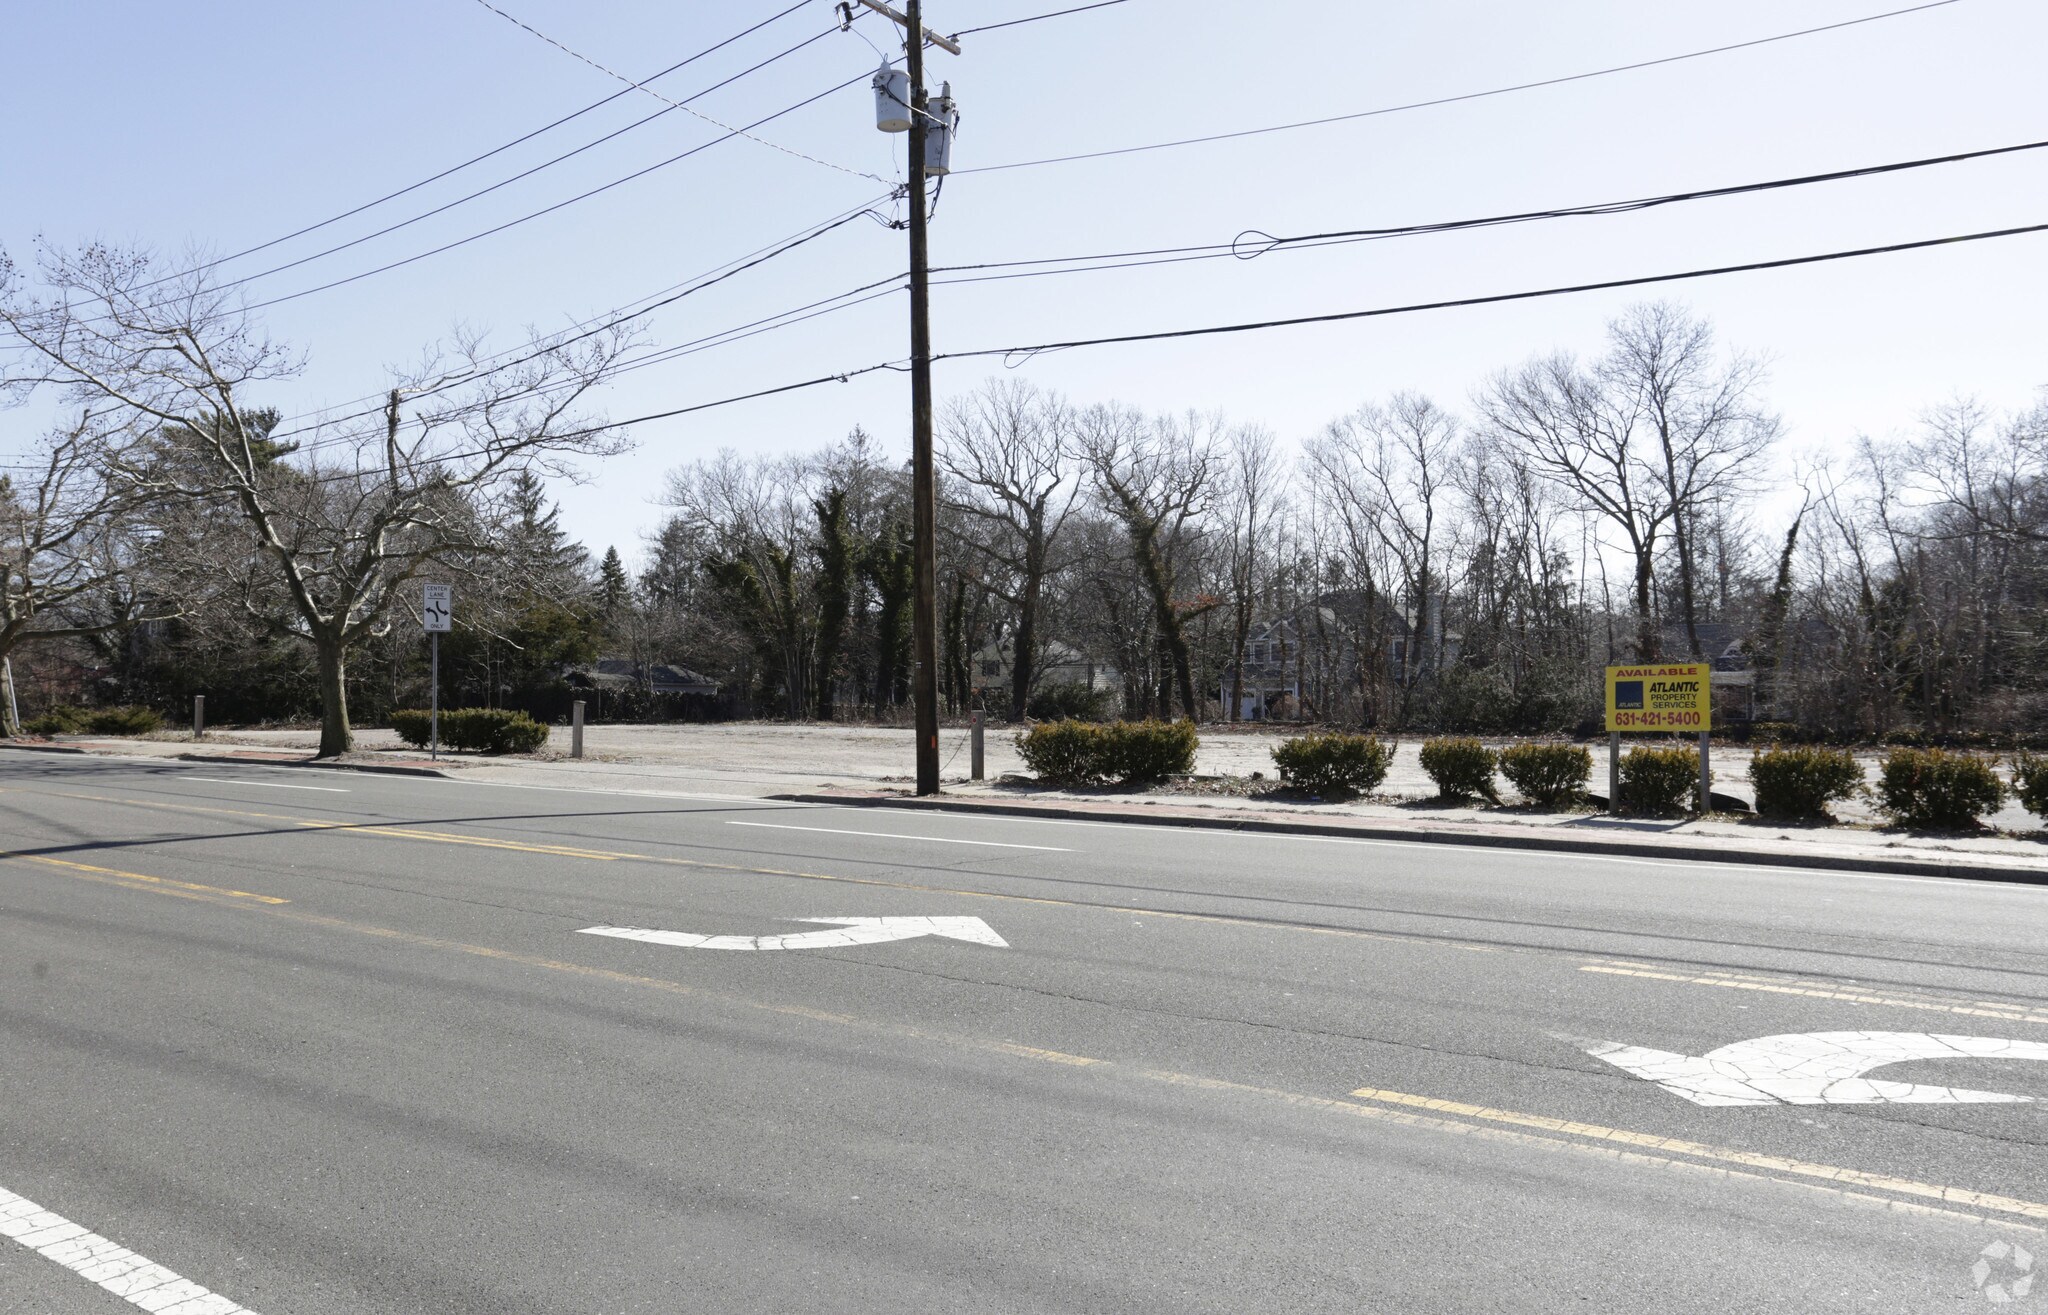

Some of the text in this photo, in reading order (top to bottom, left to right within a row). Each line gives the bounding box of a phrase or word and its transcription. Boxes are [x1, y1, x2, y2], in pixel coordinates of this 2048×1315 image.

[1616, 668, 1697, 677] AVAILABLE
[1649, 682, 1699, 693] ATLANTIC
[1652, 701, 1697, 709] SERVICES
[1615, 711, 1700, 726] 631-421-5400
